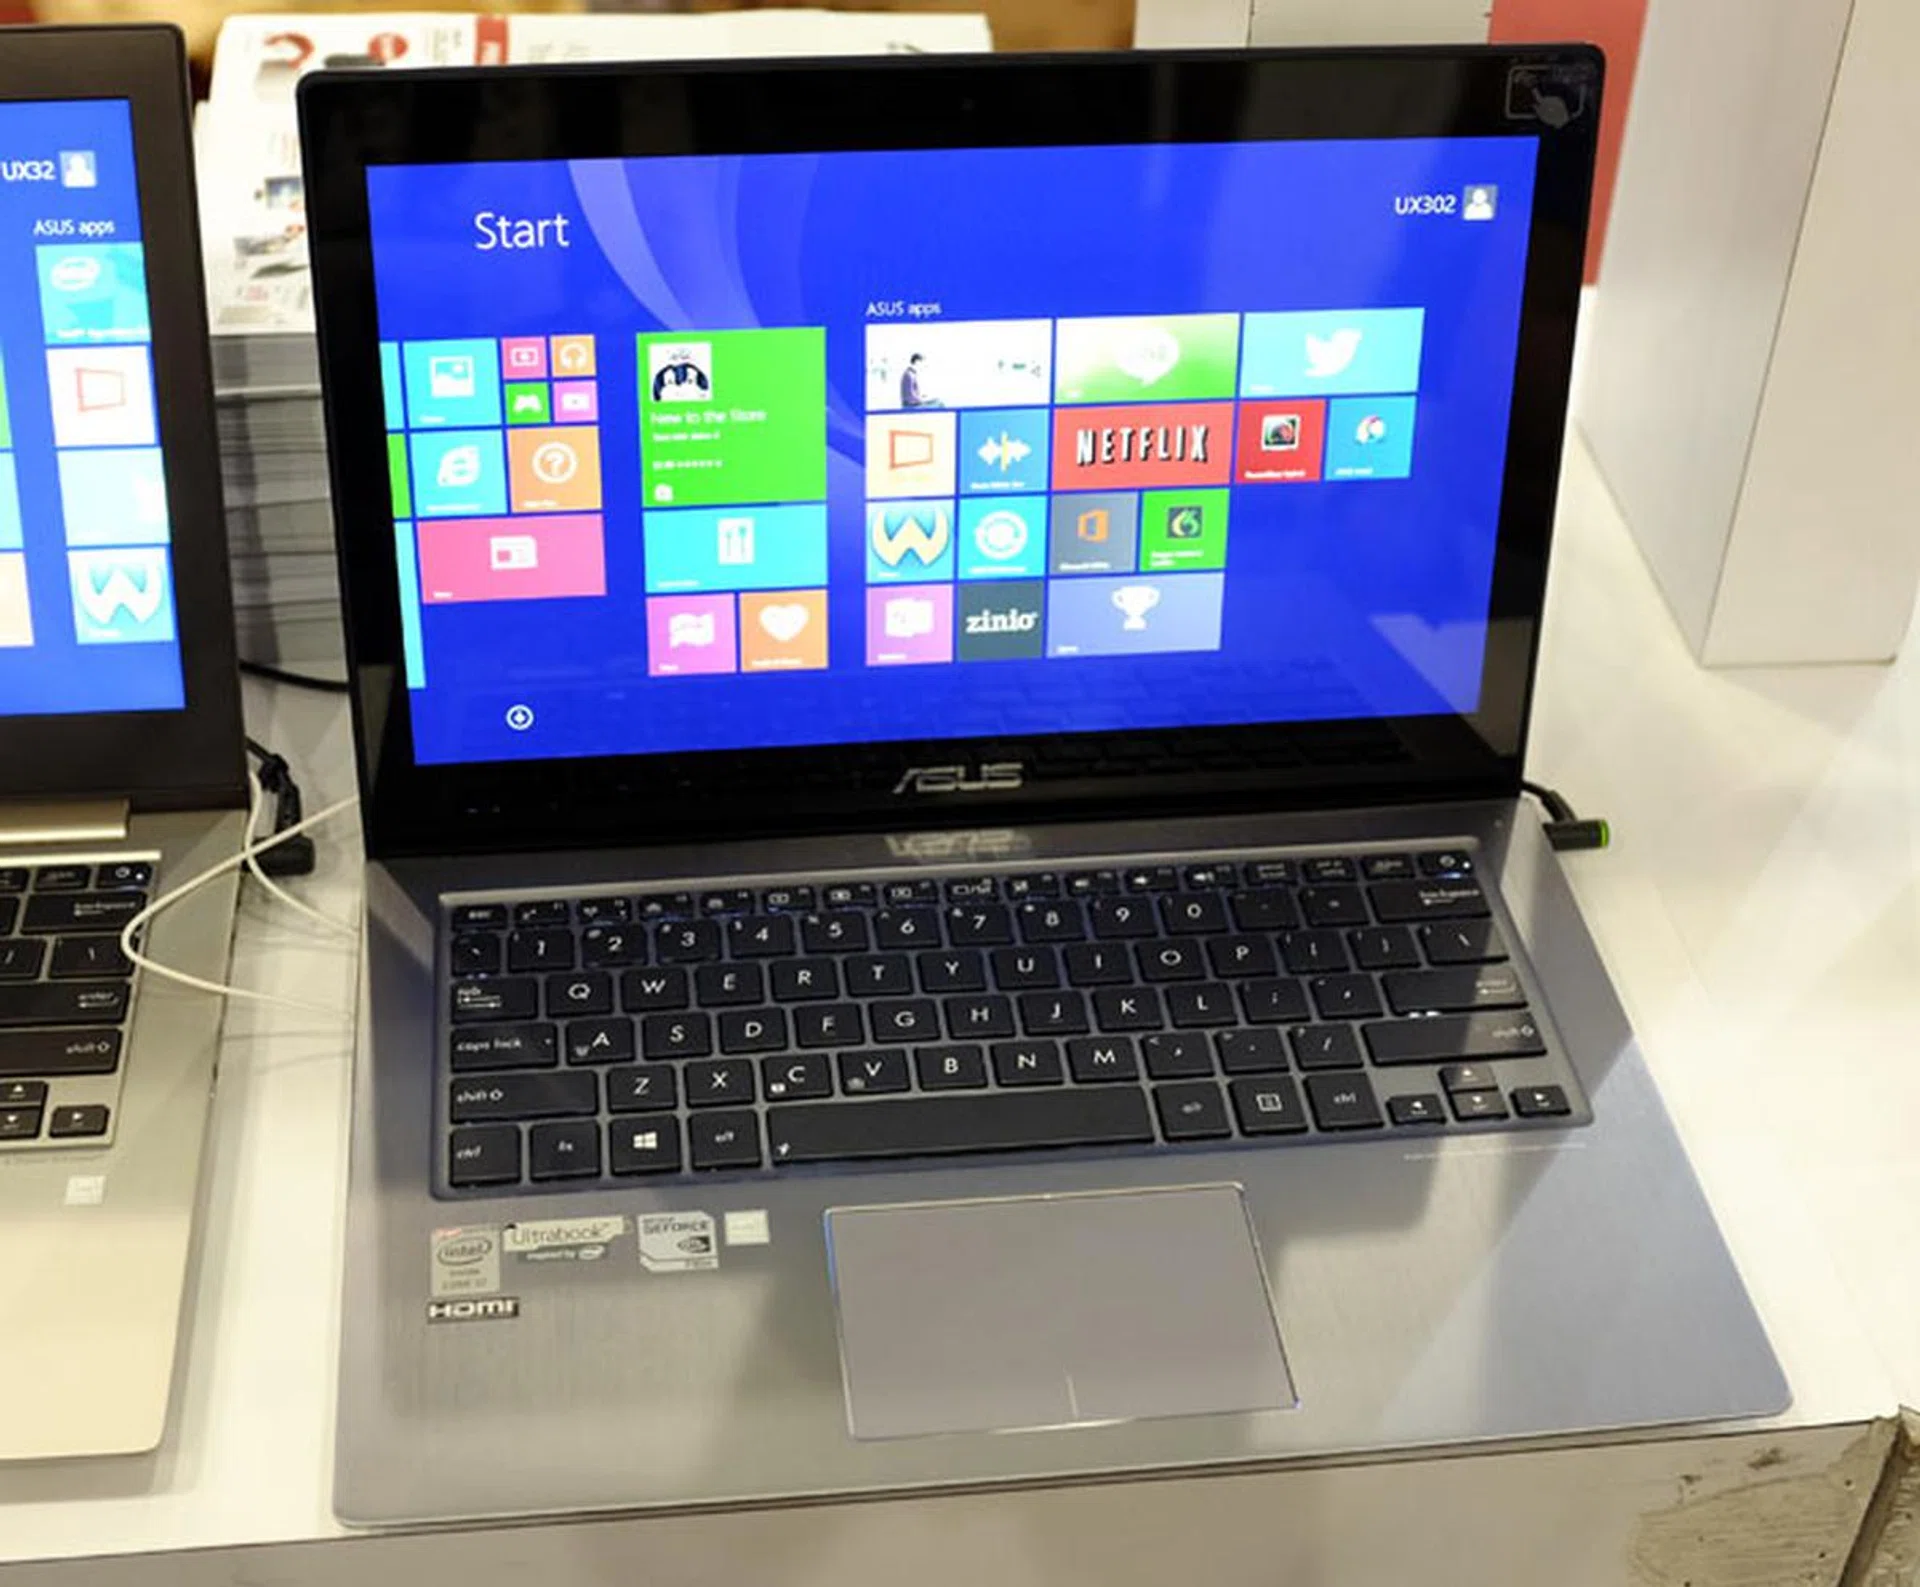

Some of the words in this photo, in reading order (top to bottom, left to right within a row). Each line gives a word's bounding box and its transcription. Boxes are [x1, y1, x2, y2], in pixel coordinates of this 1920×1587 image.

[1, 160, 56, 181] UX32
[1394, 194, 1457, 216] UX302
[33, 219, 74, 236] ASUS
[79, 220, 115, 237] apps
[474, 211, 570, 250] Start
[865, 300, 904, 317] ASUS
[908, 302, 942, 318] apps
[1076, 424, 1209, 467] NETFLIX
[965, 608, 1038, 634] zinio
[892, 762, 1024, 795] ASUS
[973, 914, 987, 930] 7
[1045, 911, 1060, 927] 8
[1115, 907, 1130, 923] 9
[756, 927, 769, 942] 4
[828, 921, 843, 938] 5
[900, 919, 915, 935] 6
[608, 936, 622, 952] 2
[681, 931, 696, 947] 3
[1160, 949, 1182, 966] O
[1236, 945, 1250, 961] P
[872, 965, 885, 981] T
[945, 960, 959, 976] Y
[1017, 957, 1034, 973] U
[723, 973, 737, 991] E
[797, 969, 812, 985] R
[568, 982, 591, 1000] Q
[641, 978, 667, 994] W
[1051, 1002, 1061, 1019] J
[1121, 999, 1137, 1015] K
[1197, 995, 1209, 1011] L
[822, 1015, 835, 1032] F
[894, 1010, 915, 1027] G
[970, 1007, 989, 1023] H
[669, 1025, 685, 1042] S
[745, 1021, 763, 1038] D
[592, 1031, 610, 1047] A
[1017, 1053, 1037, 1069] N
[1093, 1049, 1116, 1064] M
[864, 1061, 883, 1077] V
[944, 1057, 959, 1074] B
[711, 1071, 729, 1089] X
[787, 1066, 805, 1083] C
[633, 1077, 650, 1095] Z
[510, 1224, 604, 1246] Ultrabook
